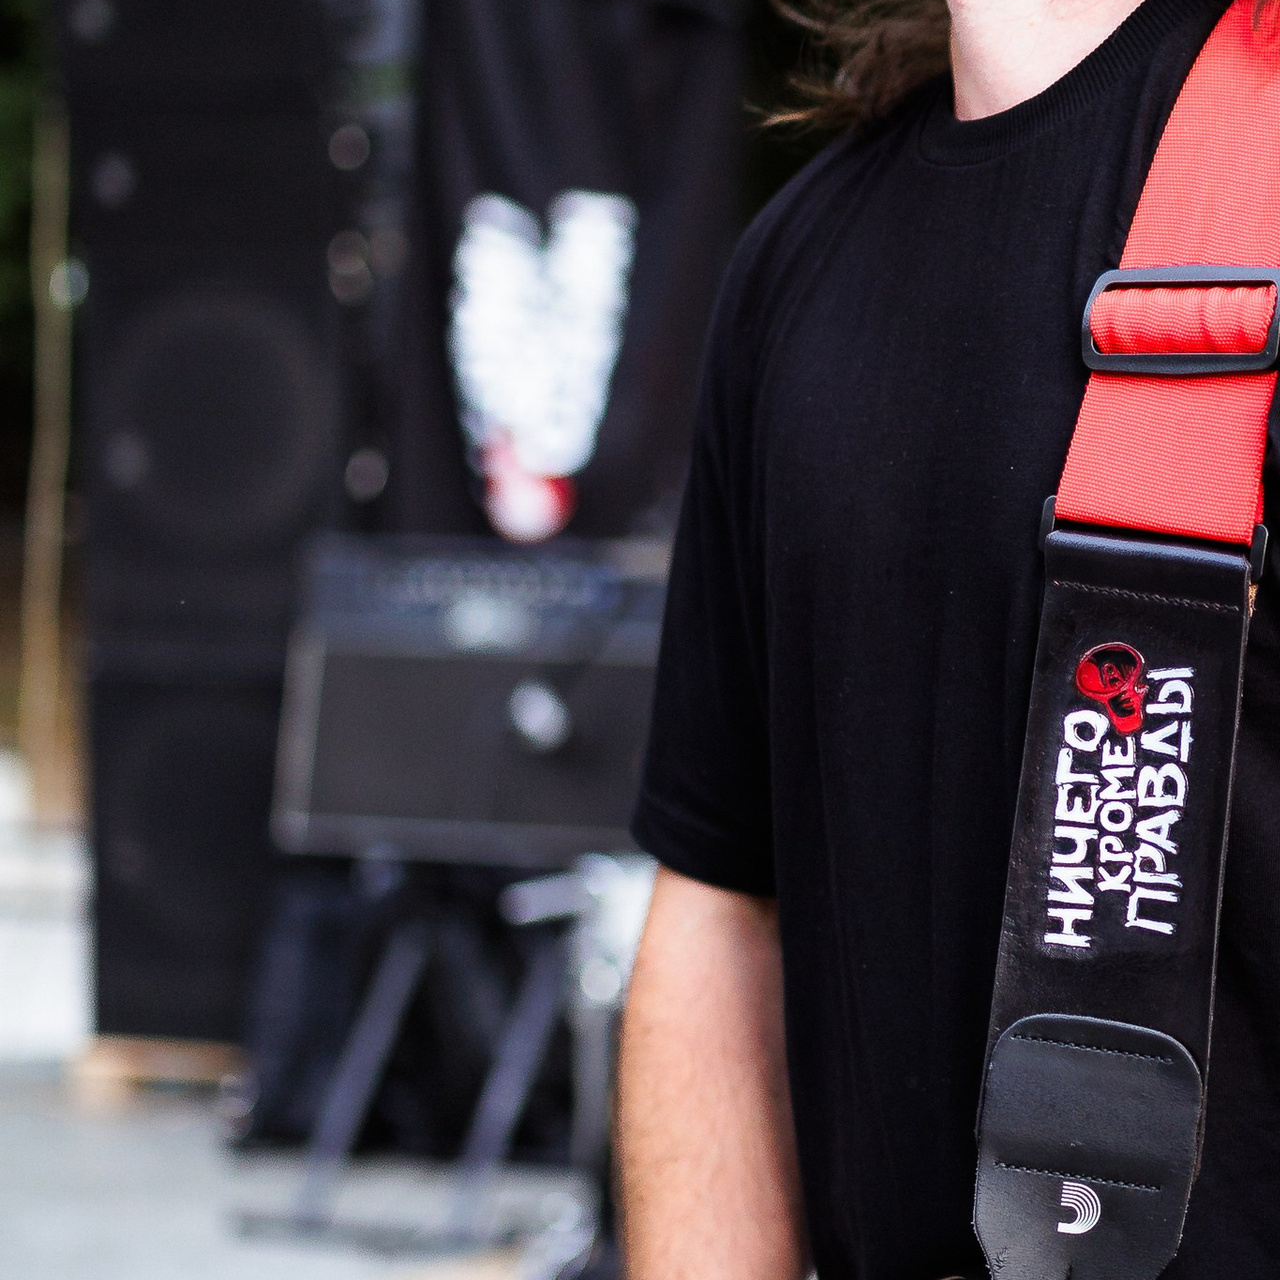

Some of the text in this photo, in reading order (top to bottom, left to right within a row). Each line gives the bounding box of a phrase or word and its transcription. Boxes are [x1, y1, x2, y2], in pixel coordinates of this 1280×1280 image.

[1044, 709, 1109, 948] НИЧЕГО
[1098, 736, 1137, 893] КРОМЕ
[1125, 666, 1195, 935] ПРАВДЫ
